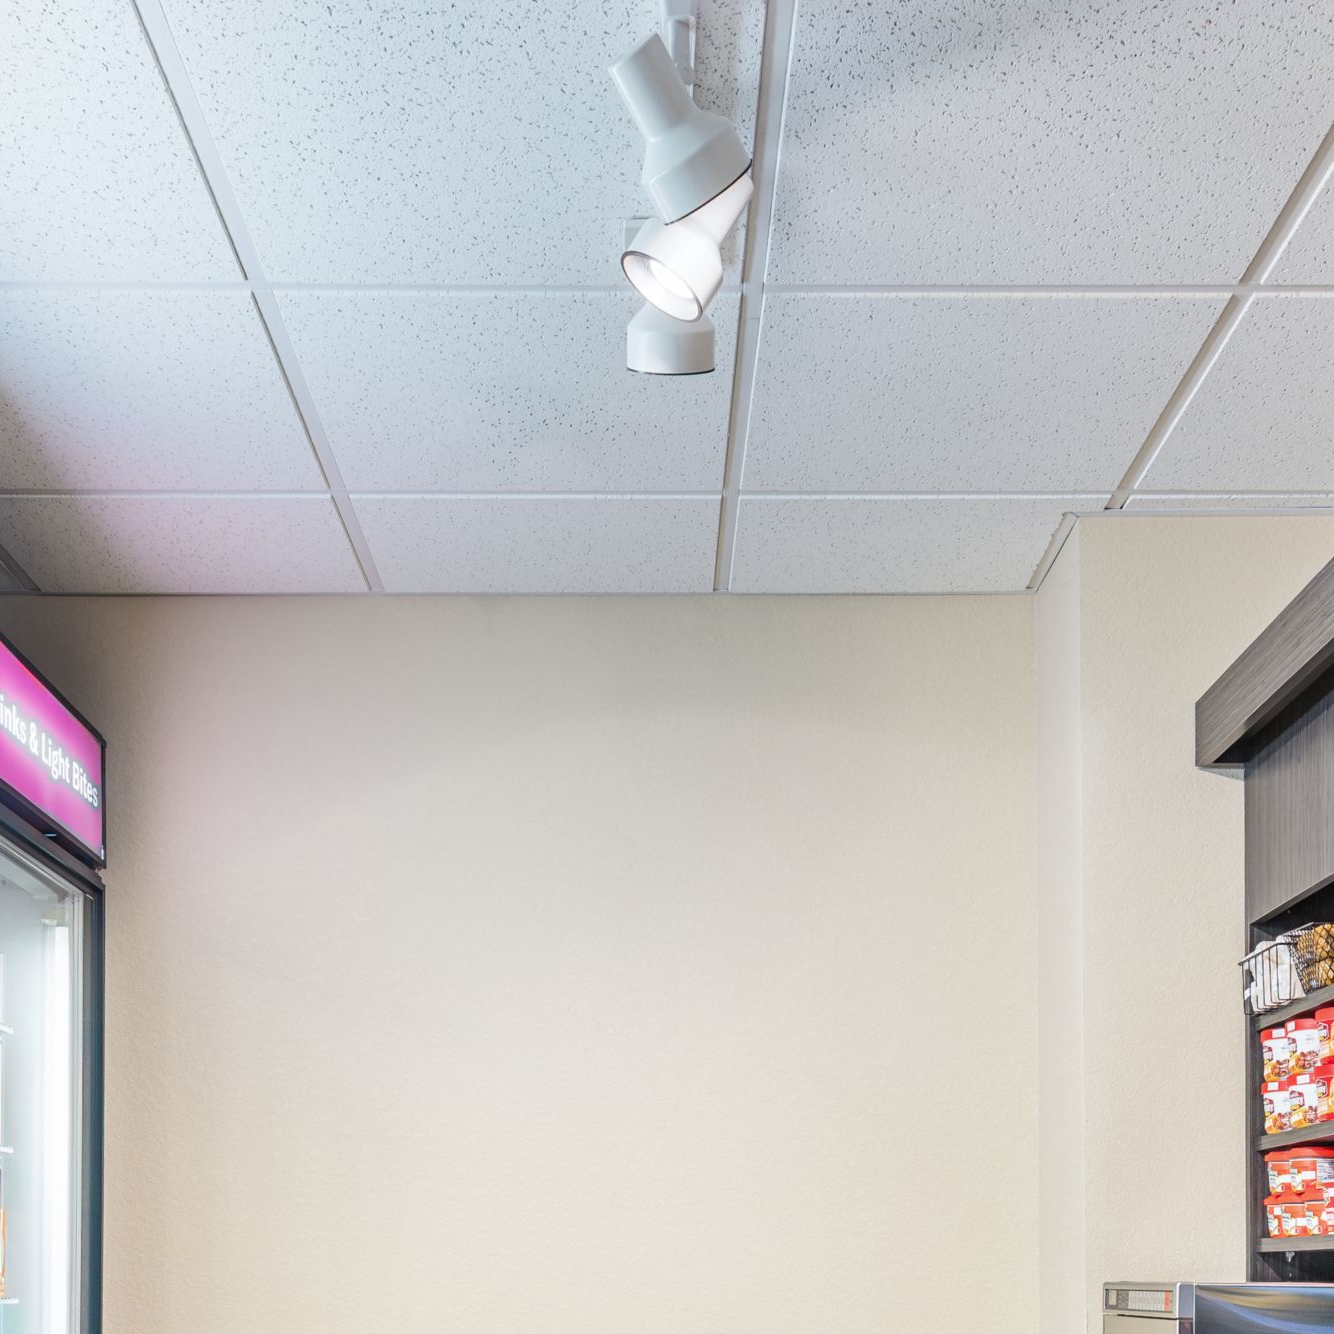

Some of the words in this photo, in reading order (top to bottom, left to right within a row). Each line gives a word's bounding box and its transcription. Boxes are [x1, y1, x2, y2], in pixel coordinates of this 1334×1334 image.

[29, 721, 39, 755] &
[41, 733, 70, 780] Light
[72, 760, 98, 808] Bites
